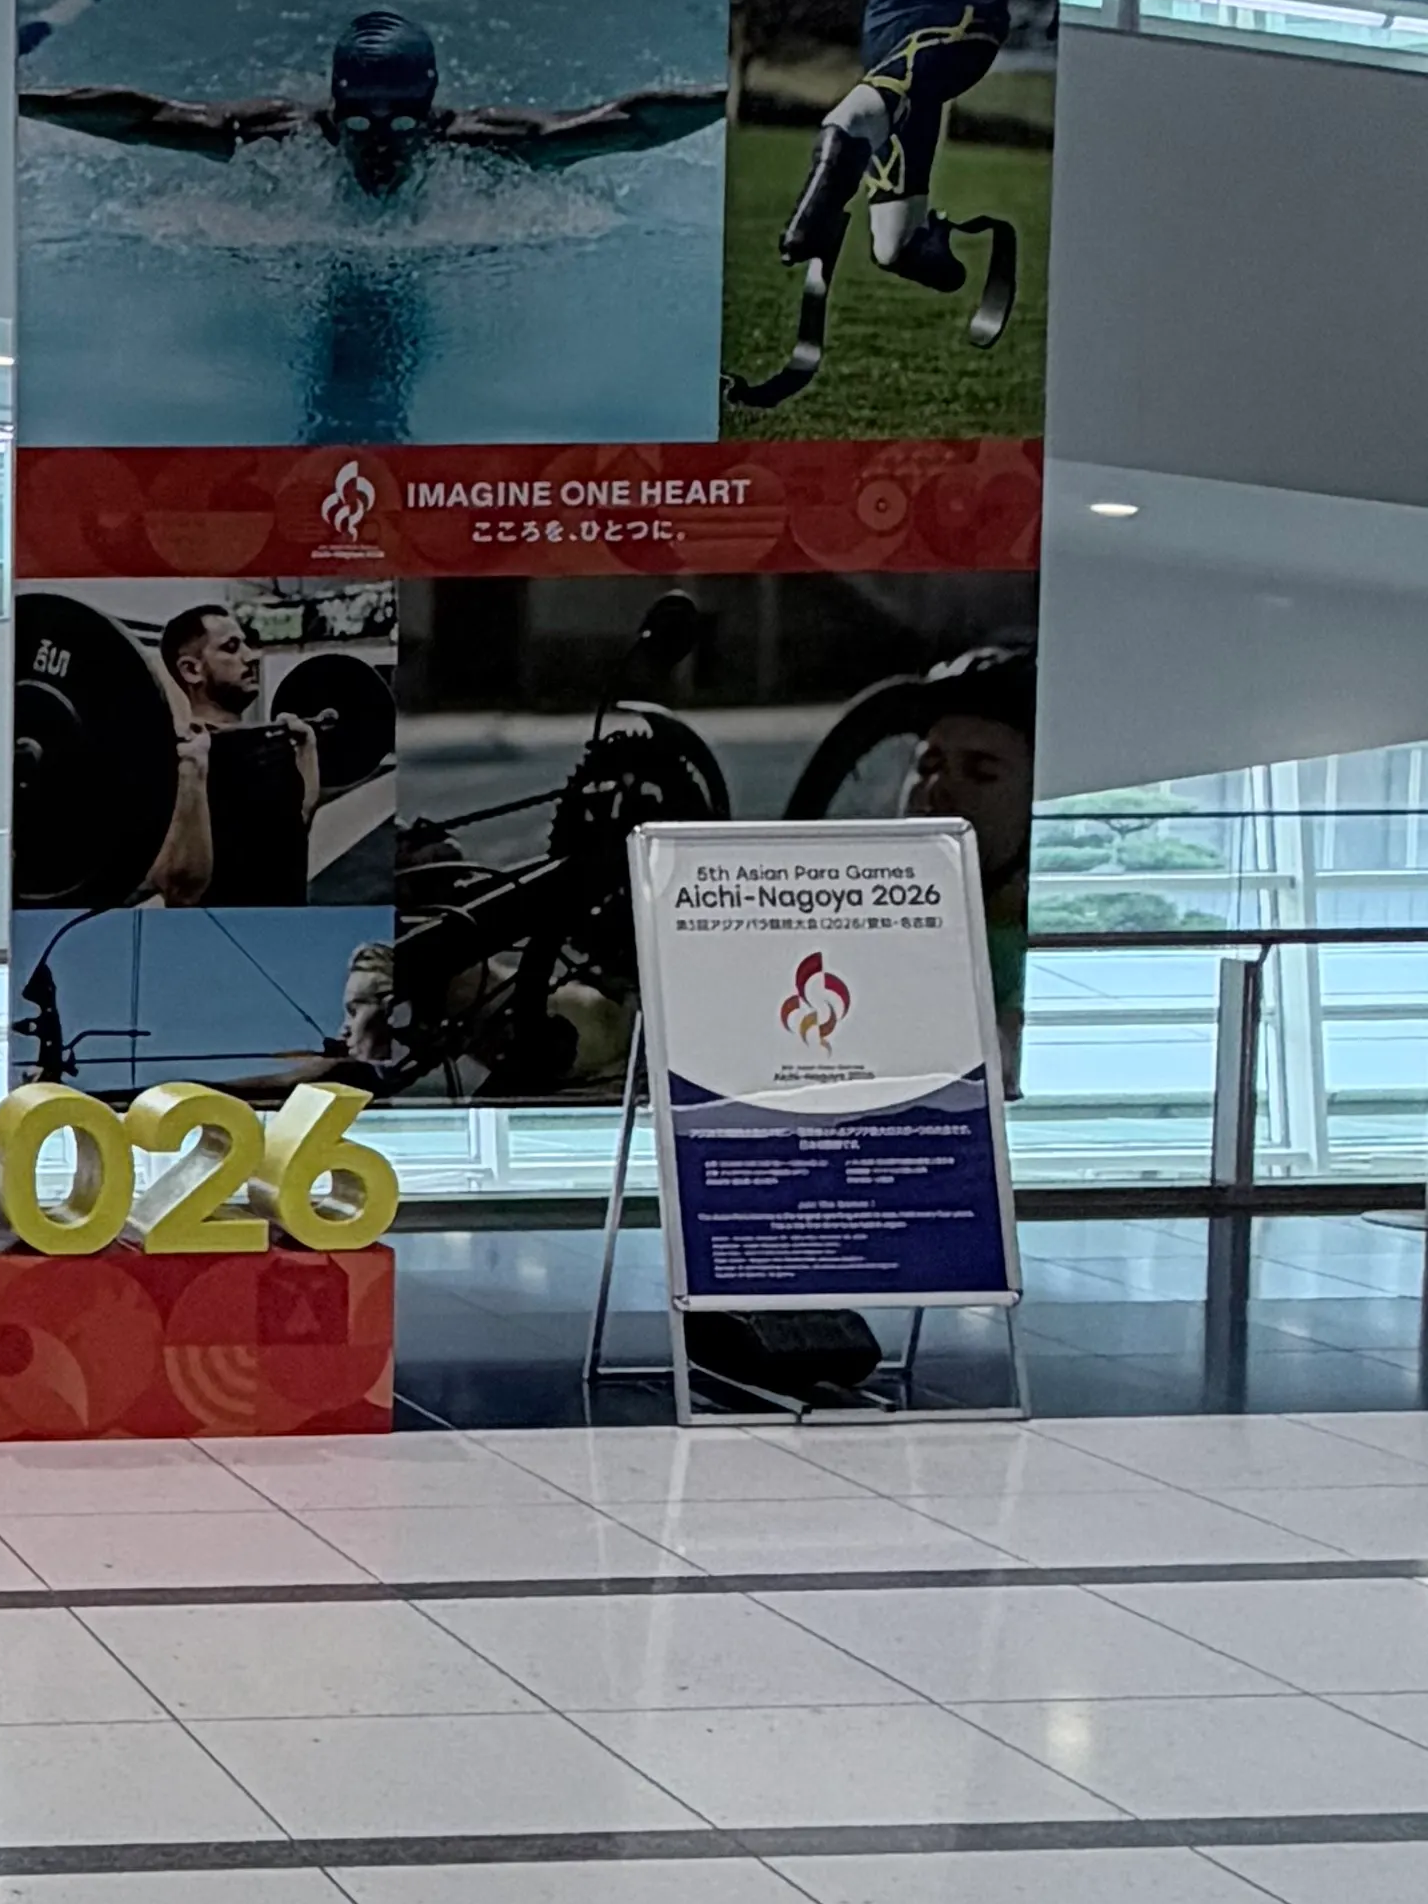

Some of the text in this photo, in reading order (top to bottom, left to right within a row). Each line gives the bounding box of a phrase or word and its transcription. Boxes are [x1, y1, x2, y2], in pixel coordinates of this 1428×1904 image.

[408, 480, 750, 507] IMAGINE ONE HEART
[473, 520, 684, 542] こころを、ひとつに。
[696, 865, 915, 882] 5th Asian Para Games
[676, 885, 940, 913] Aichi-Nagoya 2026
